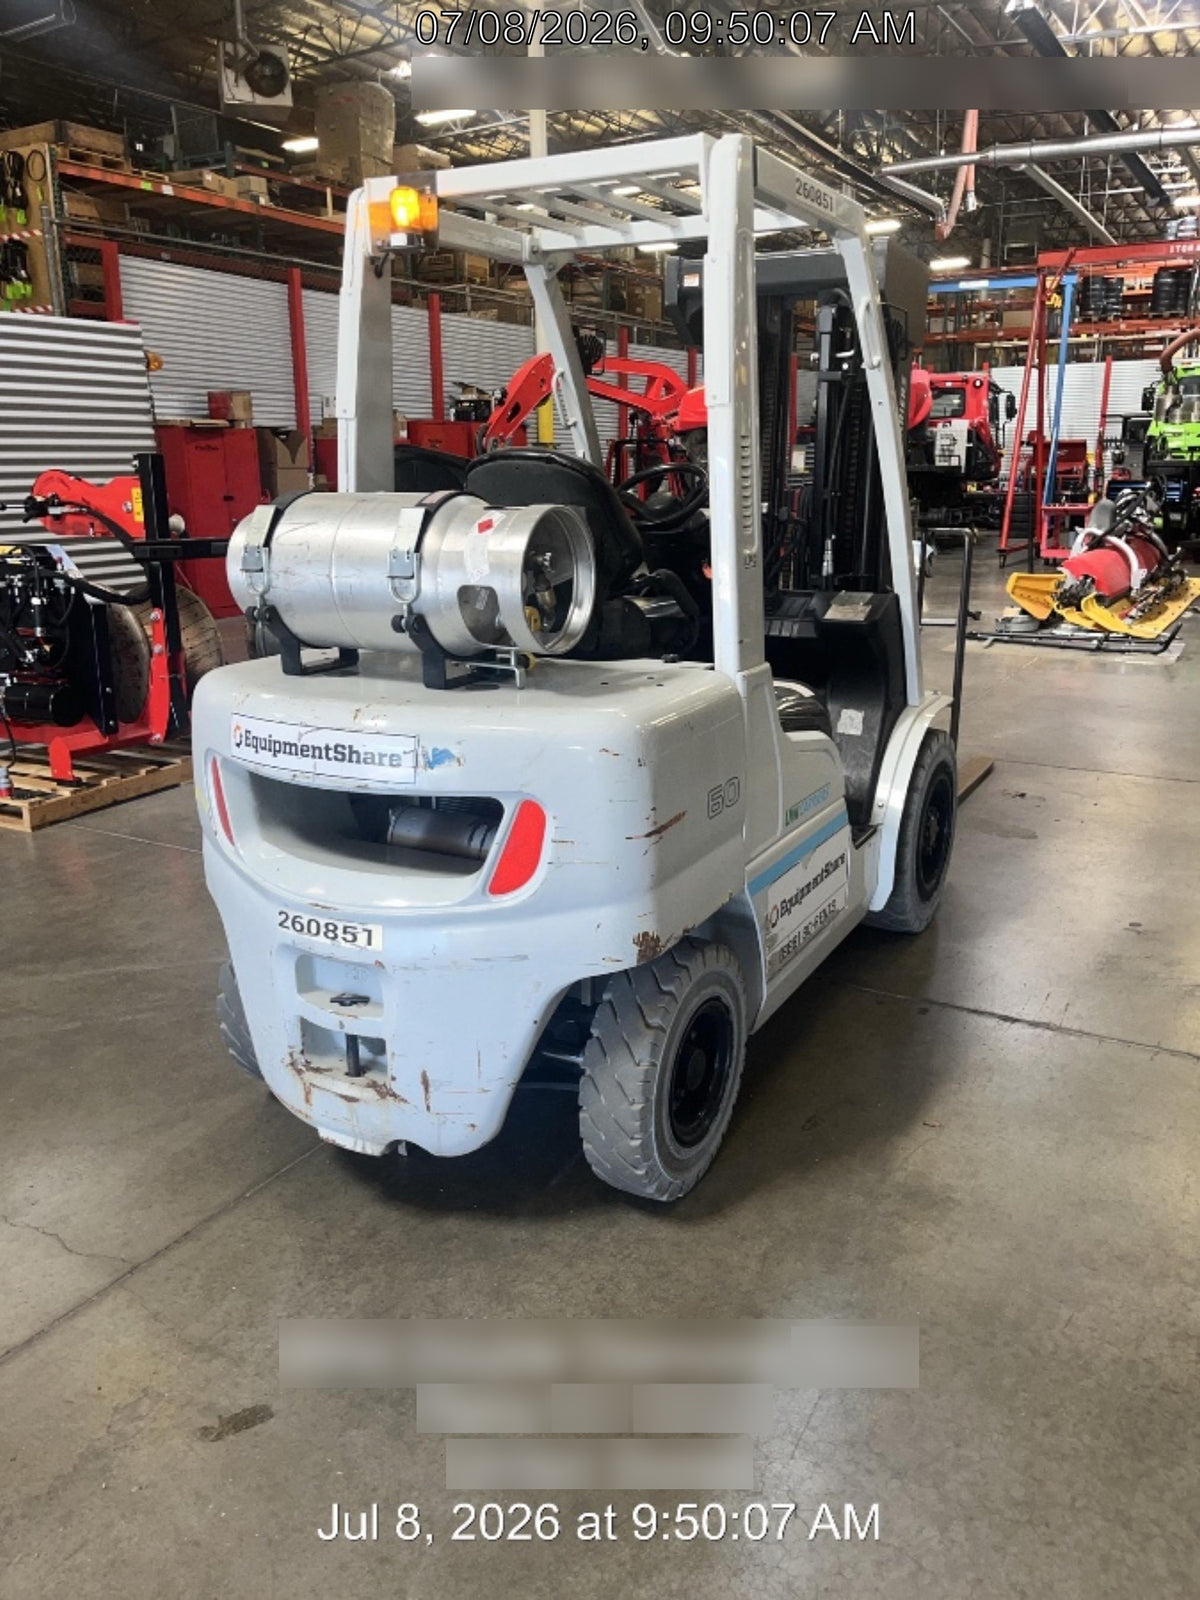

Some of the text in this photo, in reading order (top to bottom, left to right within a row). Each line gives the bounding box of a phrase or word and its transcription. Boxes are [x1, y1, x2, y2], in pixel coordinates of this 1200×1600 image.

[796, 177, 833, 212] 260851
[244, 729, 403, 768] EquipmentShare
[707, 776, 740, 820] 60
[780, 852, 846, 919] EquipmentShare
[278, 910, 372, 946] 260851
